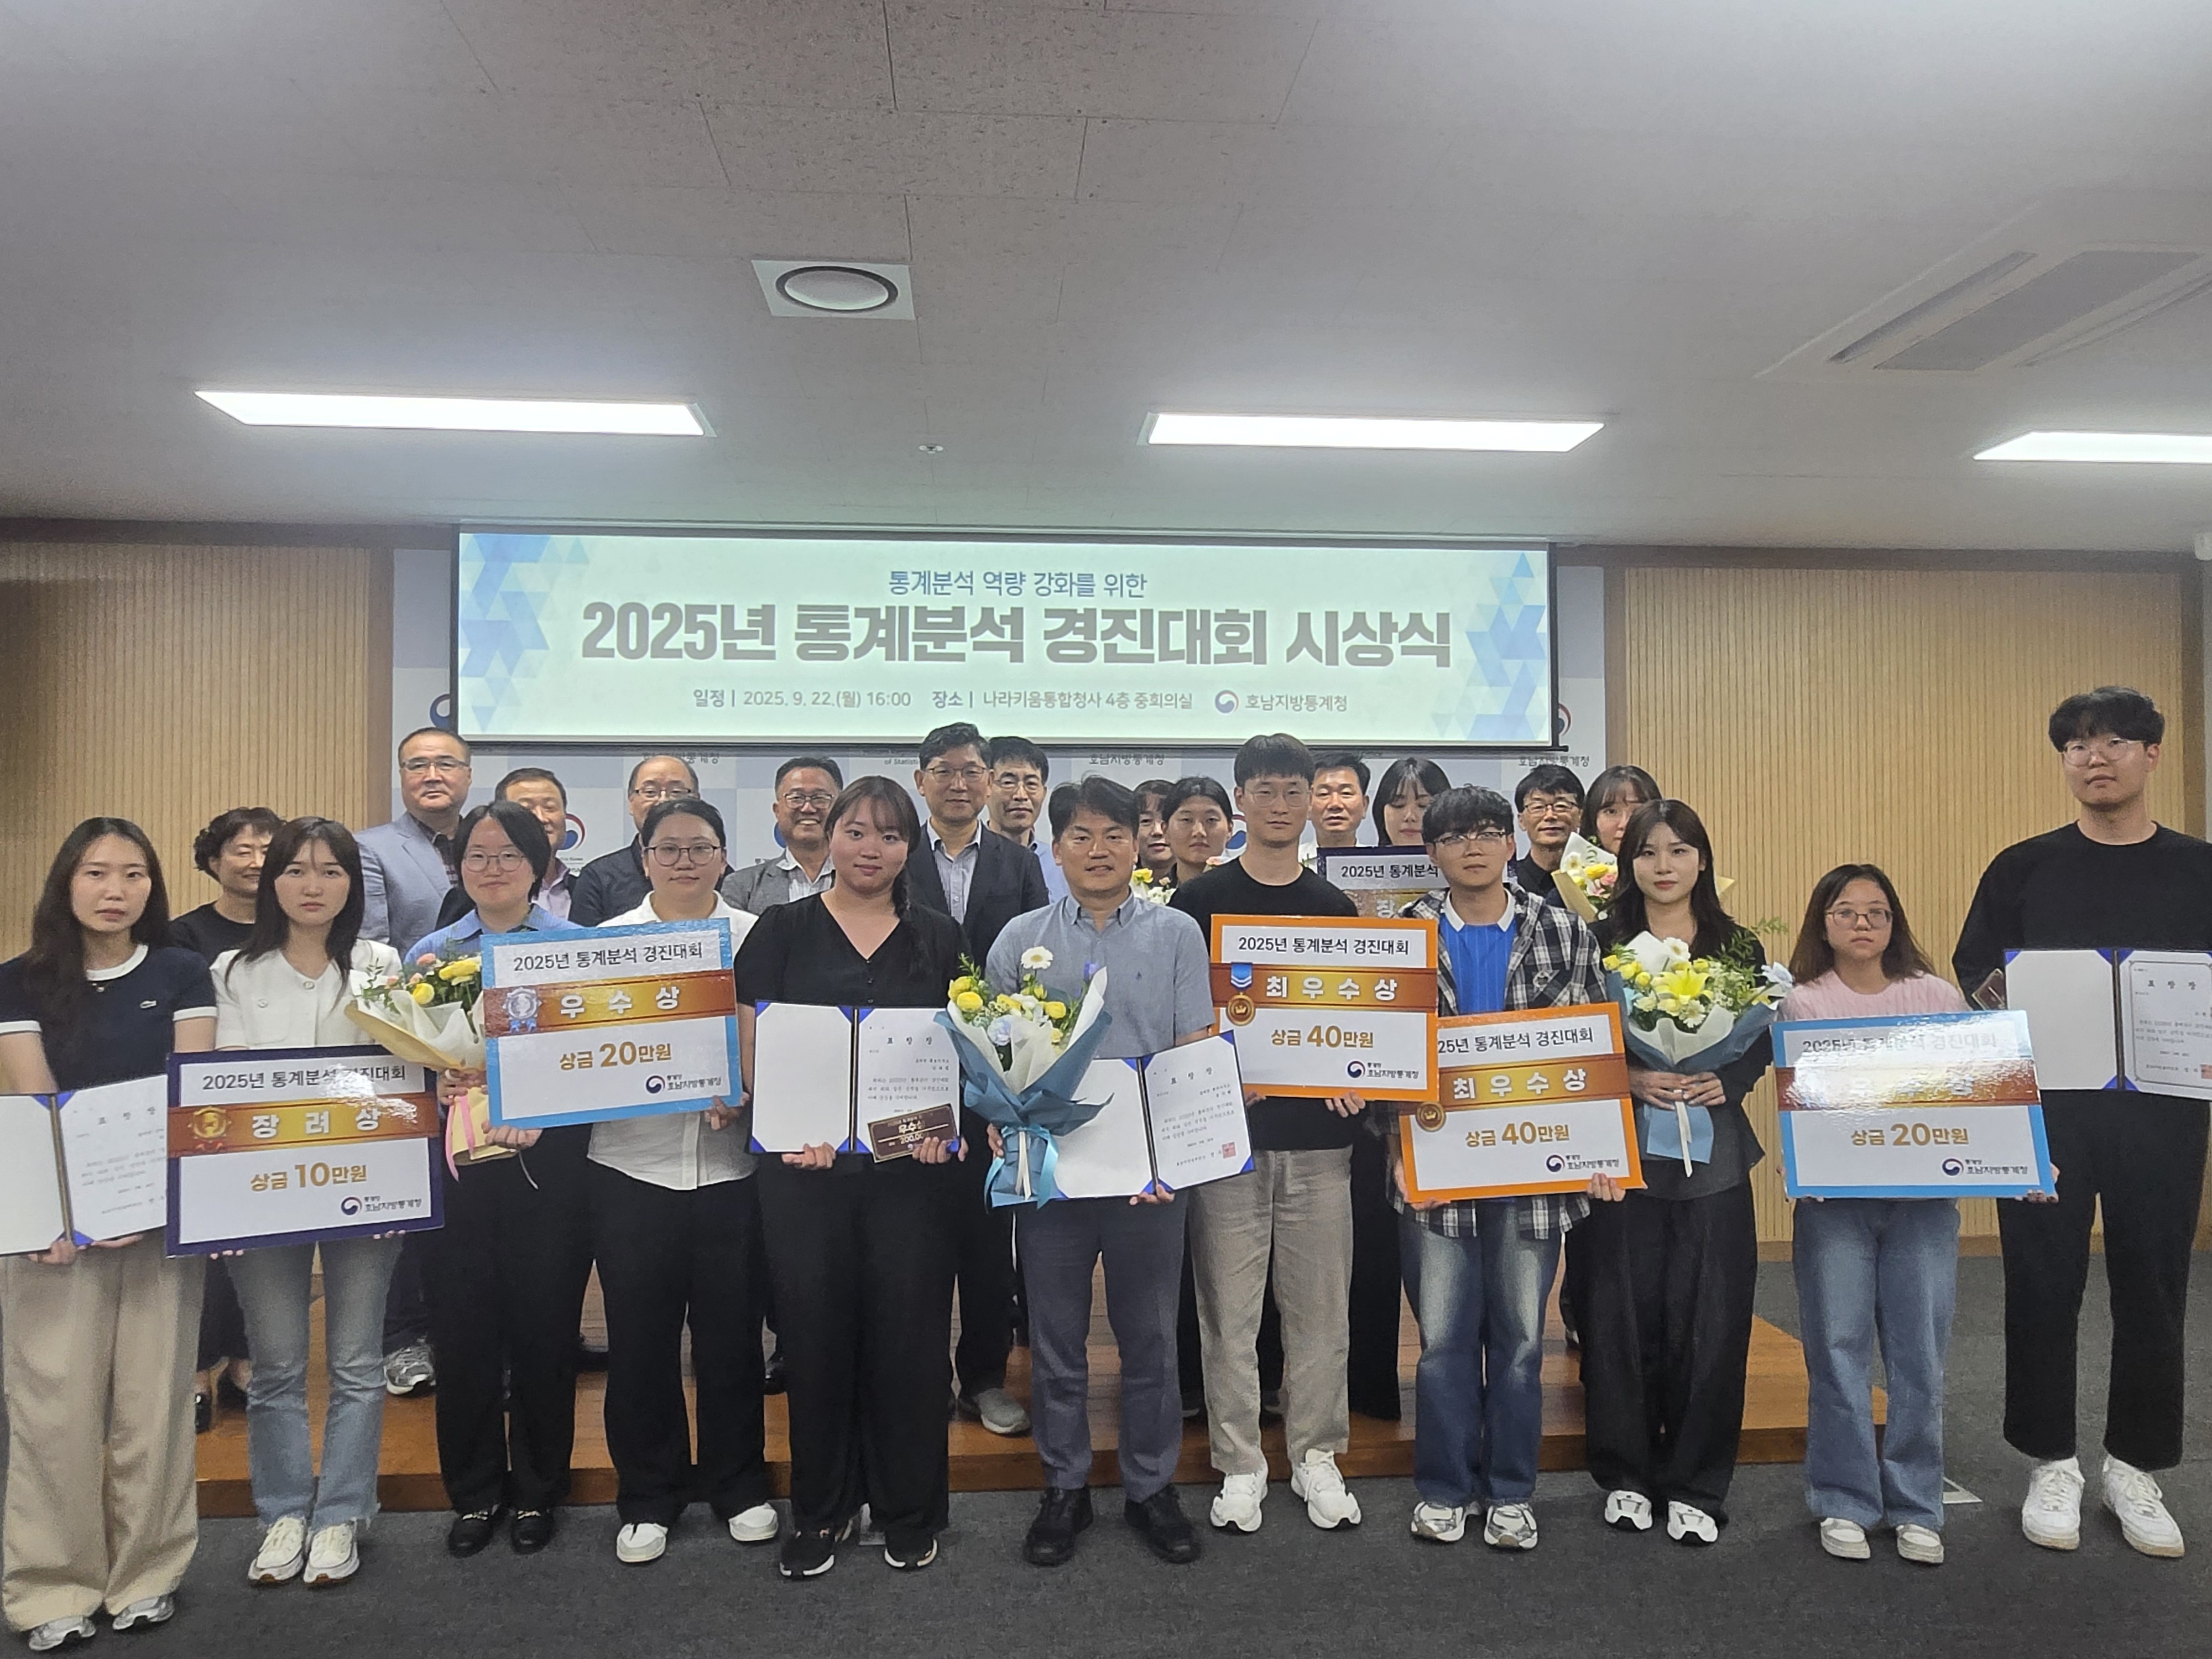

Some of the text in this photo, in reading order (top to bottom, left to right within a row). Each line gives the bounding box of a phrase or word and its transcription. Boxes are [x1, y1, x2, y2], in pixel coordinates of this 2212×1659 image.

[889, 570, 1147, 598] 통계분석 역량 강화를 위한
[582, 602, 1451, 667] 2025년 통계분석 경진대회 시상식
[693, 689, 725, 707] 일정
[744, 691, 788, 706] 2025.
[793, 691, 806, 706] 9.
[812, 690, 861, 708] 22.(월)
[867, 691, 911, 706] 16:00
[932, 691, 963, 709] 장소
[983, 691, 1102, 708] 나라키움통합청사
[1105, 692, 1130, 708] 4층
[1135, 692, 1193, 709] 중회의실
[1245, 695, 1348, 712] 호남지방통계청
[1089, 752, 1164, 766] 호남지방통계청
[1341, 864, 1438, 878] 2025년 통계분석
[514, 942, 703, 972] 2025년 통계분석 경진대회
[1239, 937, 1409, 954] 2025년 통계분석 경진대회
[1271, 1025, 1374, 1048] 상금 40만원
[1438, 1027, 1593, 1053] 25년 통계분석 경진대회
[560, 1041, 672, 1071] 상금 20만원
[202, 1073, 264, 1090] 2025년
[342, 1065, 406, 1082] 진대회
[1465, 1121, 1569, 1147] 상금 40만원
[1851, 1123, 1969, 1146] 상금 20만원
[251, 1162, 367, 1192] 상금 10만원
